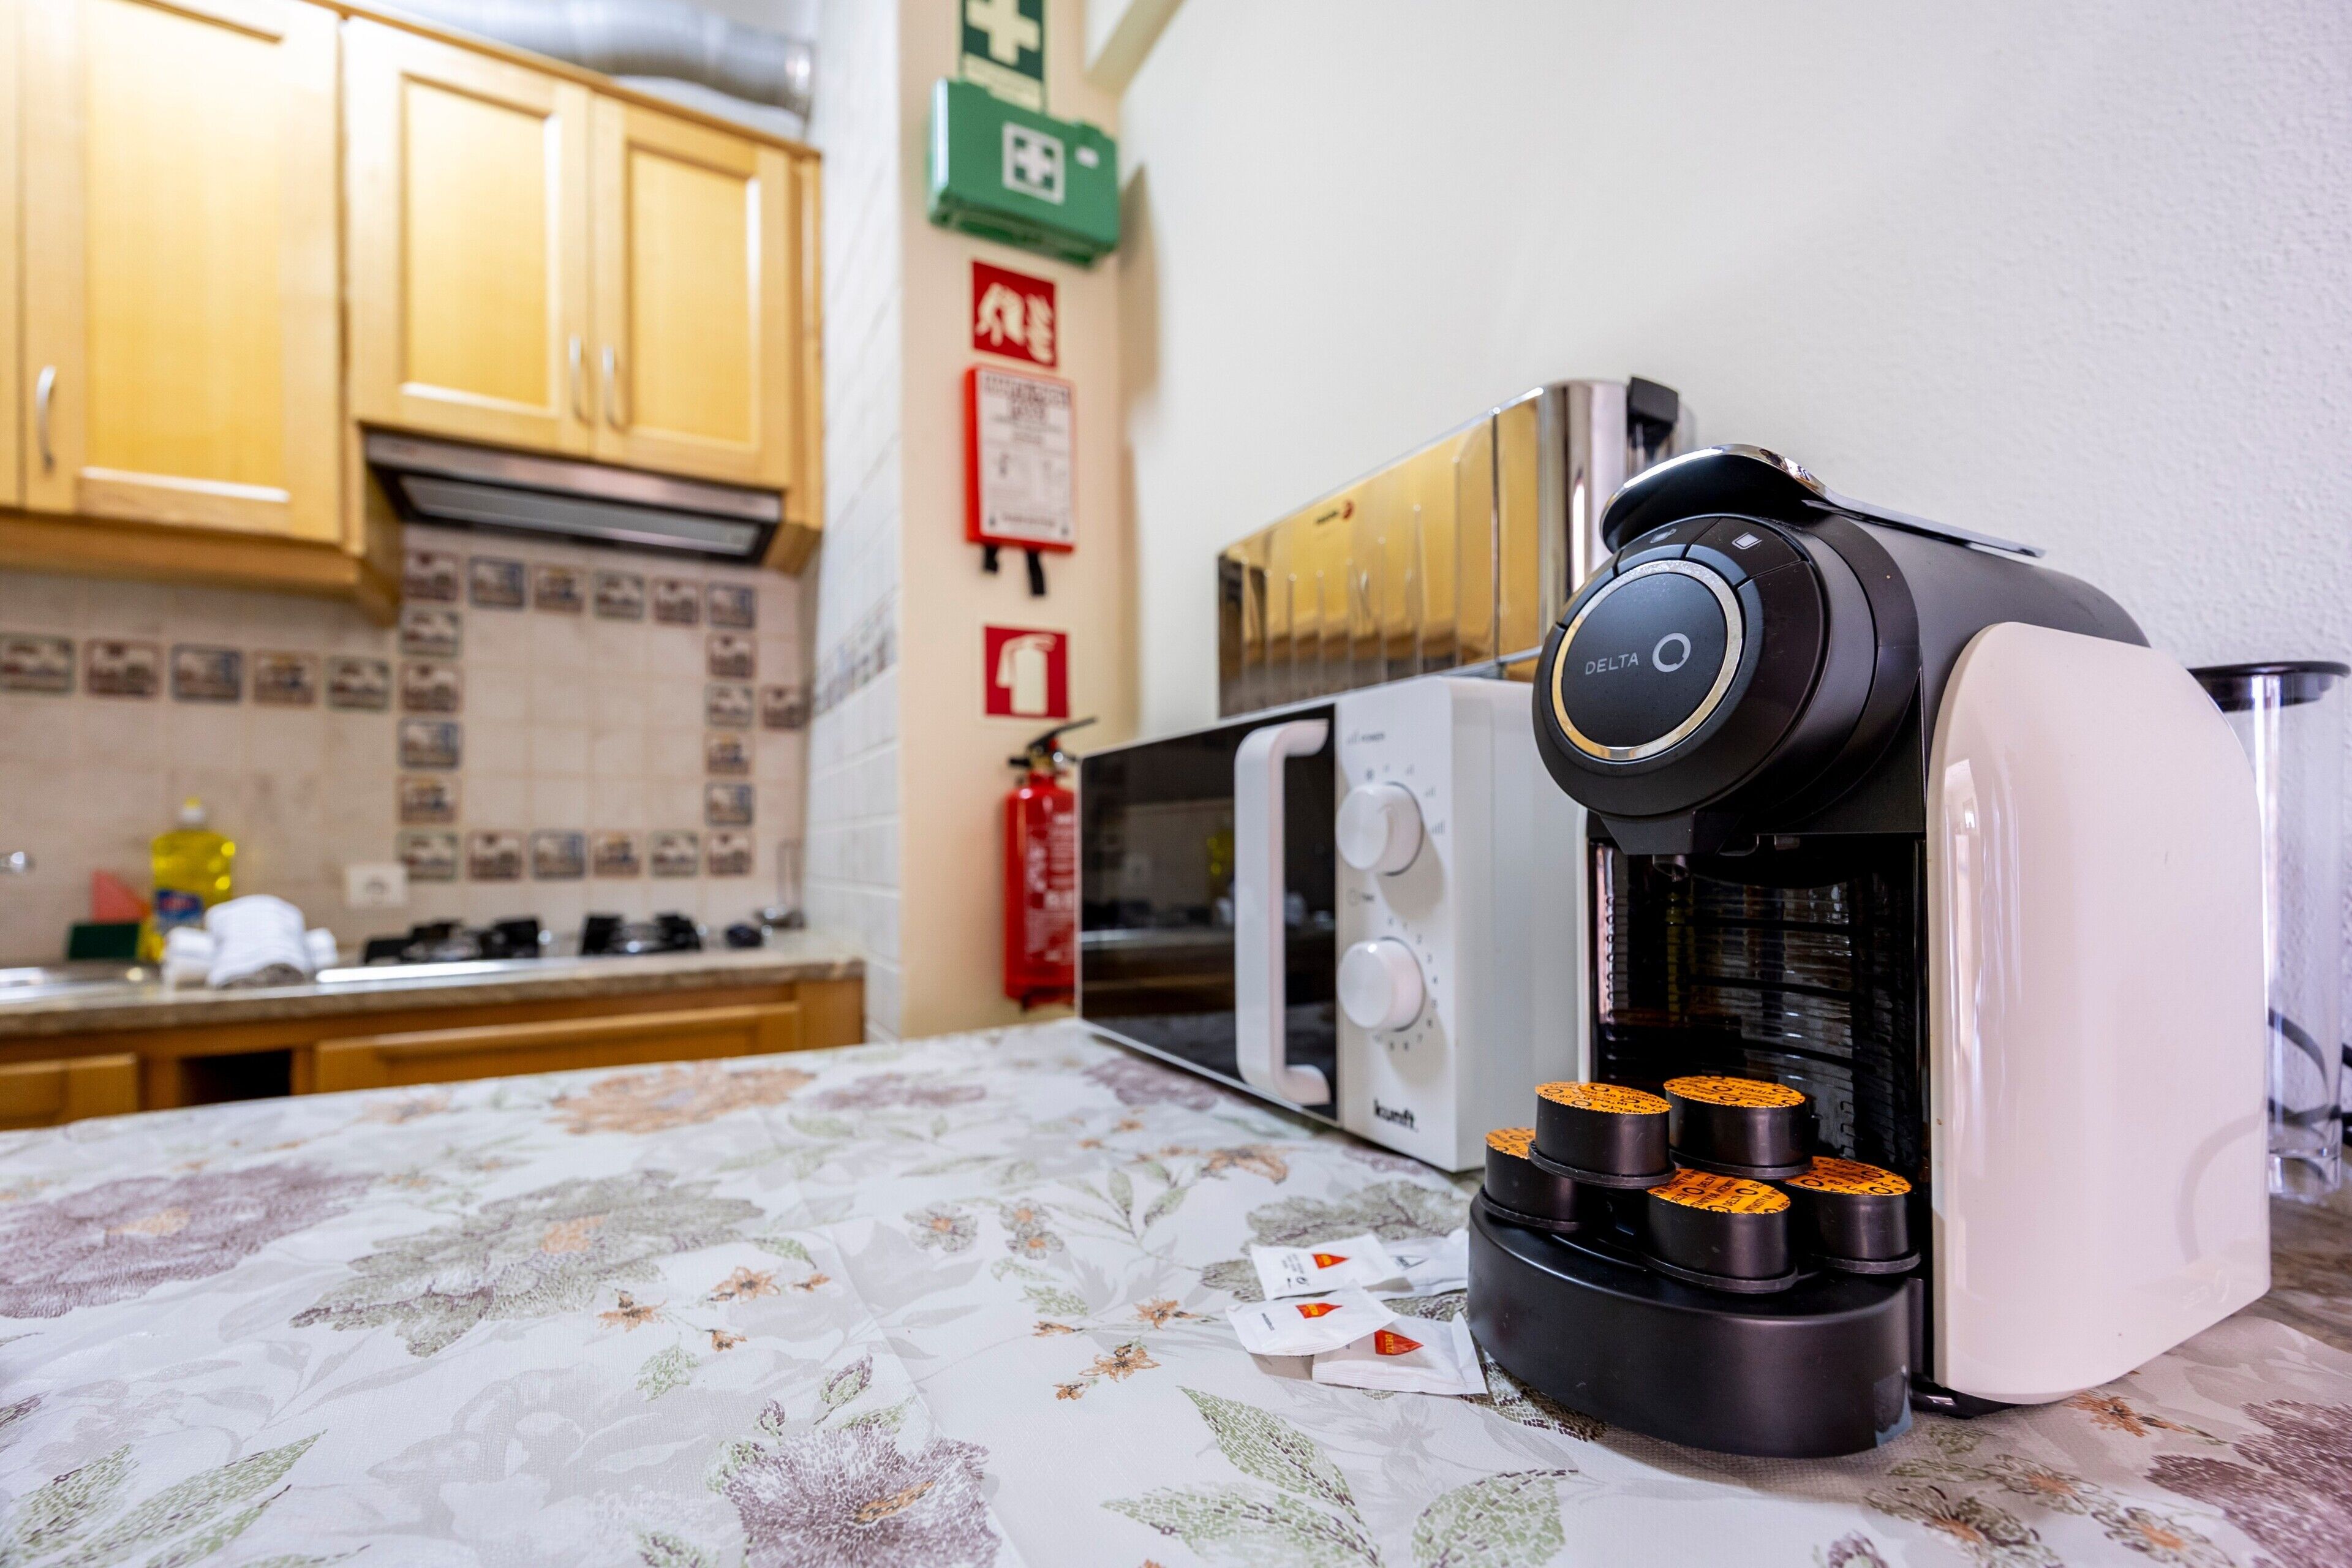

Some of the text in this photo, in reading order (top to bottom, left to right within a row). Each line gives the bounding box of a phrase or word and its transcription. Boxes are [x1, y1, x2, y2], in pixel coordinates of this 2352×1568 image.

[1585, 652, 1639, 676] DELTA
[1722, 1195, 1745, 1207] DELTA
[1385, 1334, 1393, 1354] DELTA
